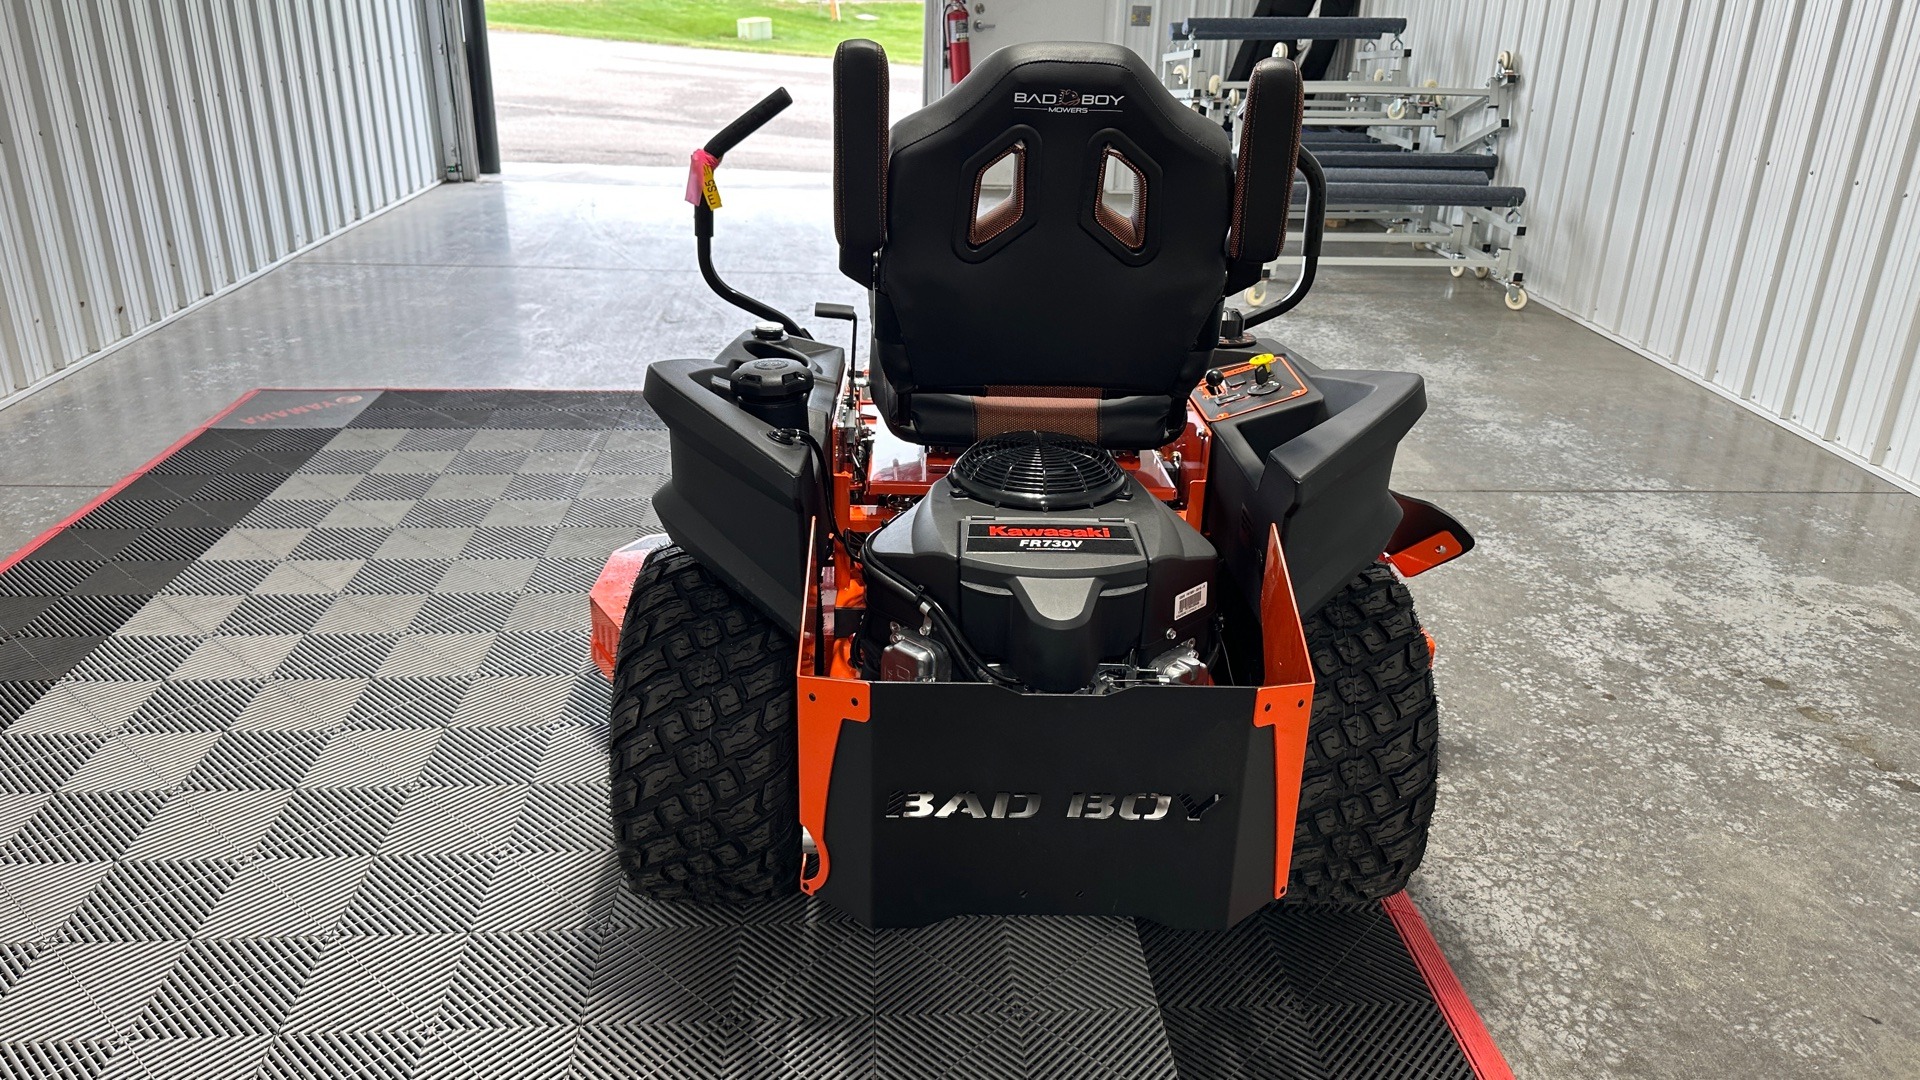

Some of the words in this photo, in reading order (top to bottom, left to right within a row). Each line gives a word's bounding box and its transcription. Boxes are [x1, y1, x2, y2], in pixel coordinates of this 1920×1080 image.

[1013, 92, 1057, 105] BAD
[1081, 94, 1125, 106] BOY
[1048, 106, 1088, 114] MOWERS
[988, 525, 1111, 539] Kawasaki
[1019, 539, 1083, 548] FR730V
[885, 790, 1042, 819] BAD
[1066, 792, 1225, 822] BOY
